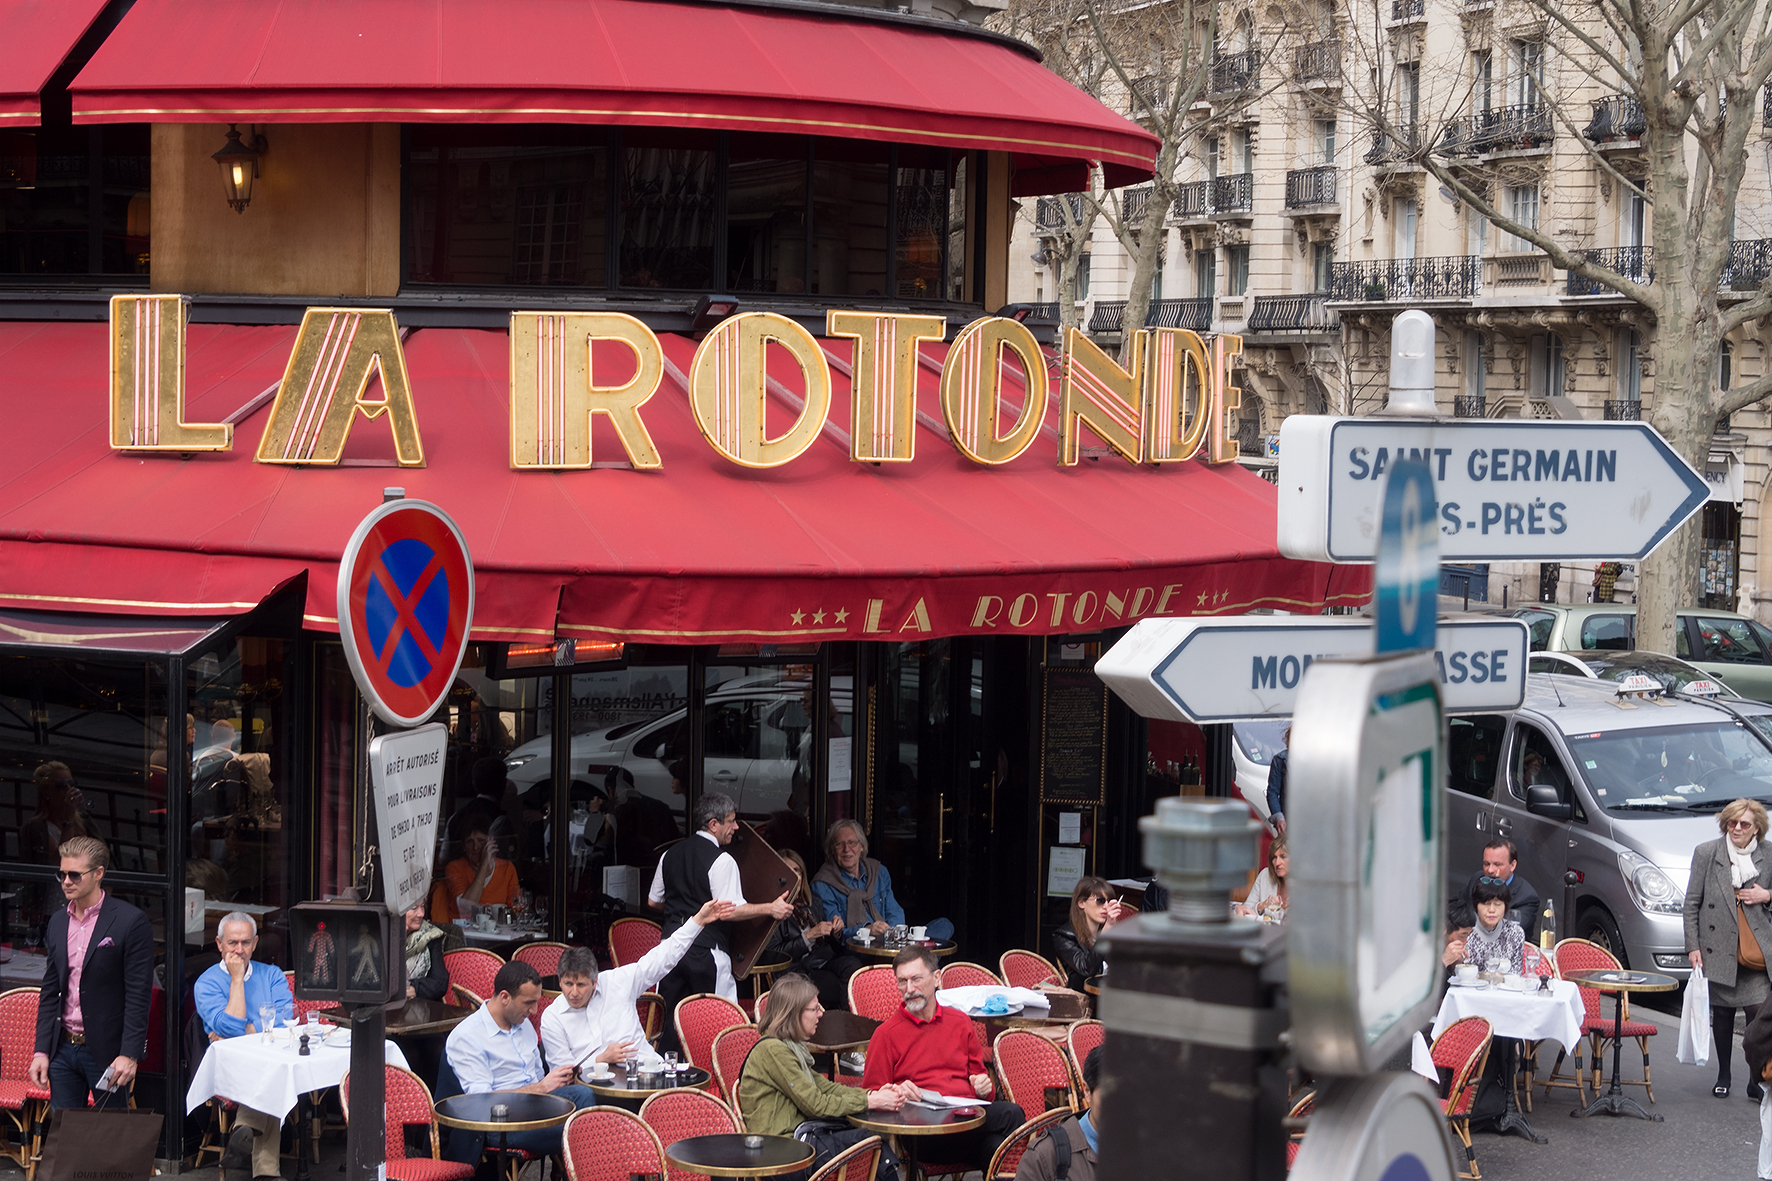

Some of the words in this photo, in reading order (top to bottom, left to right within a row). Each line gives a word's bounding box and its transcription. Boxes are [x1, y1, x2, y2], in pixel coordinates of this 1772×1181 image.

[109, 293, 428, 468] LA
[509, 308, 1244, 469] ROTONDE
[1467, 448, 1618, 482] GERMAIN
[1434, 497, 1568, 536] S-PRÉS
[862, 596, 933, 634] LA
[969, 583, 1184, 628] ROTONDE
[1629, 676, 1648, 685] TAXI
[386, 756, 404, 776] ARRÊT
[405, 748, 440, 771] AUTORISÉ
[387, 793, 400, 809] POUR
[400, 783, 437, 805] LIVRAISONS
[390, 825, 397, 840] DE
[410, 816, 415, 830] A
[416, 811, 433, 828] 7H30
[408, 845, 415, 860] DE
[73, 1171, 98, 1179] LOUIS
[100, 1171, 134, 1180] VUITTON
